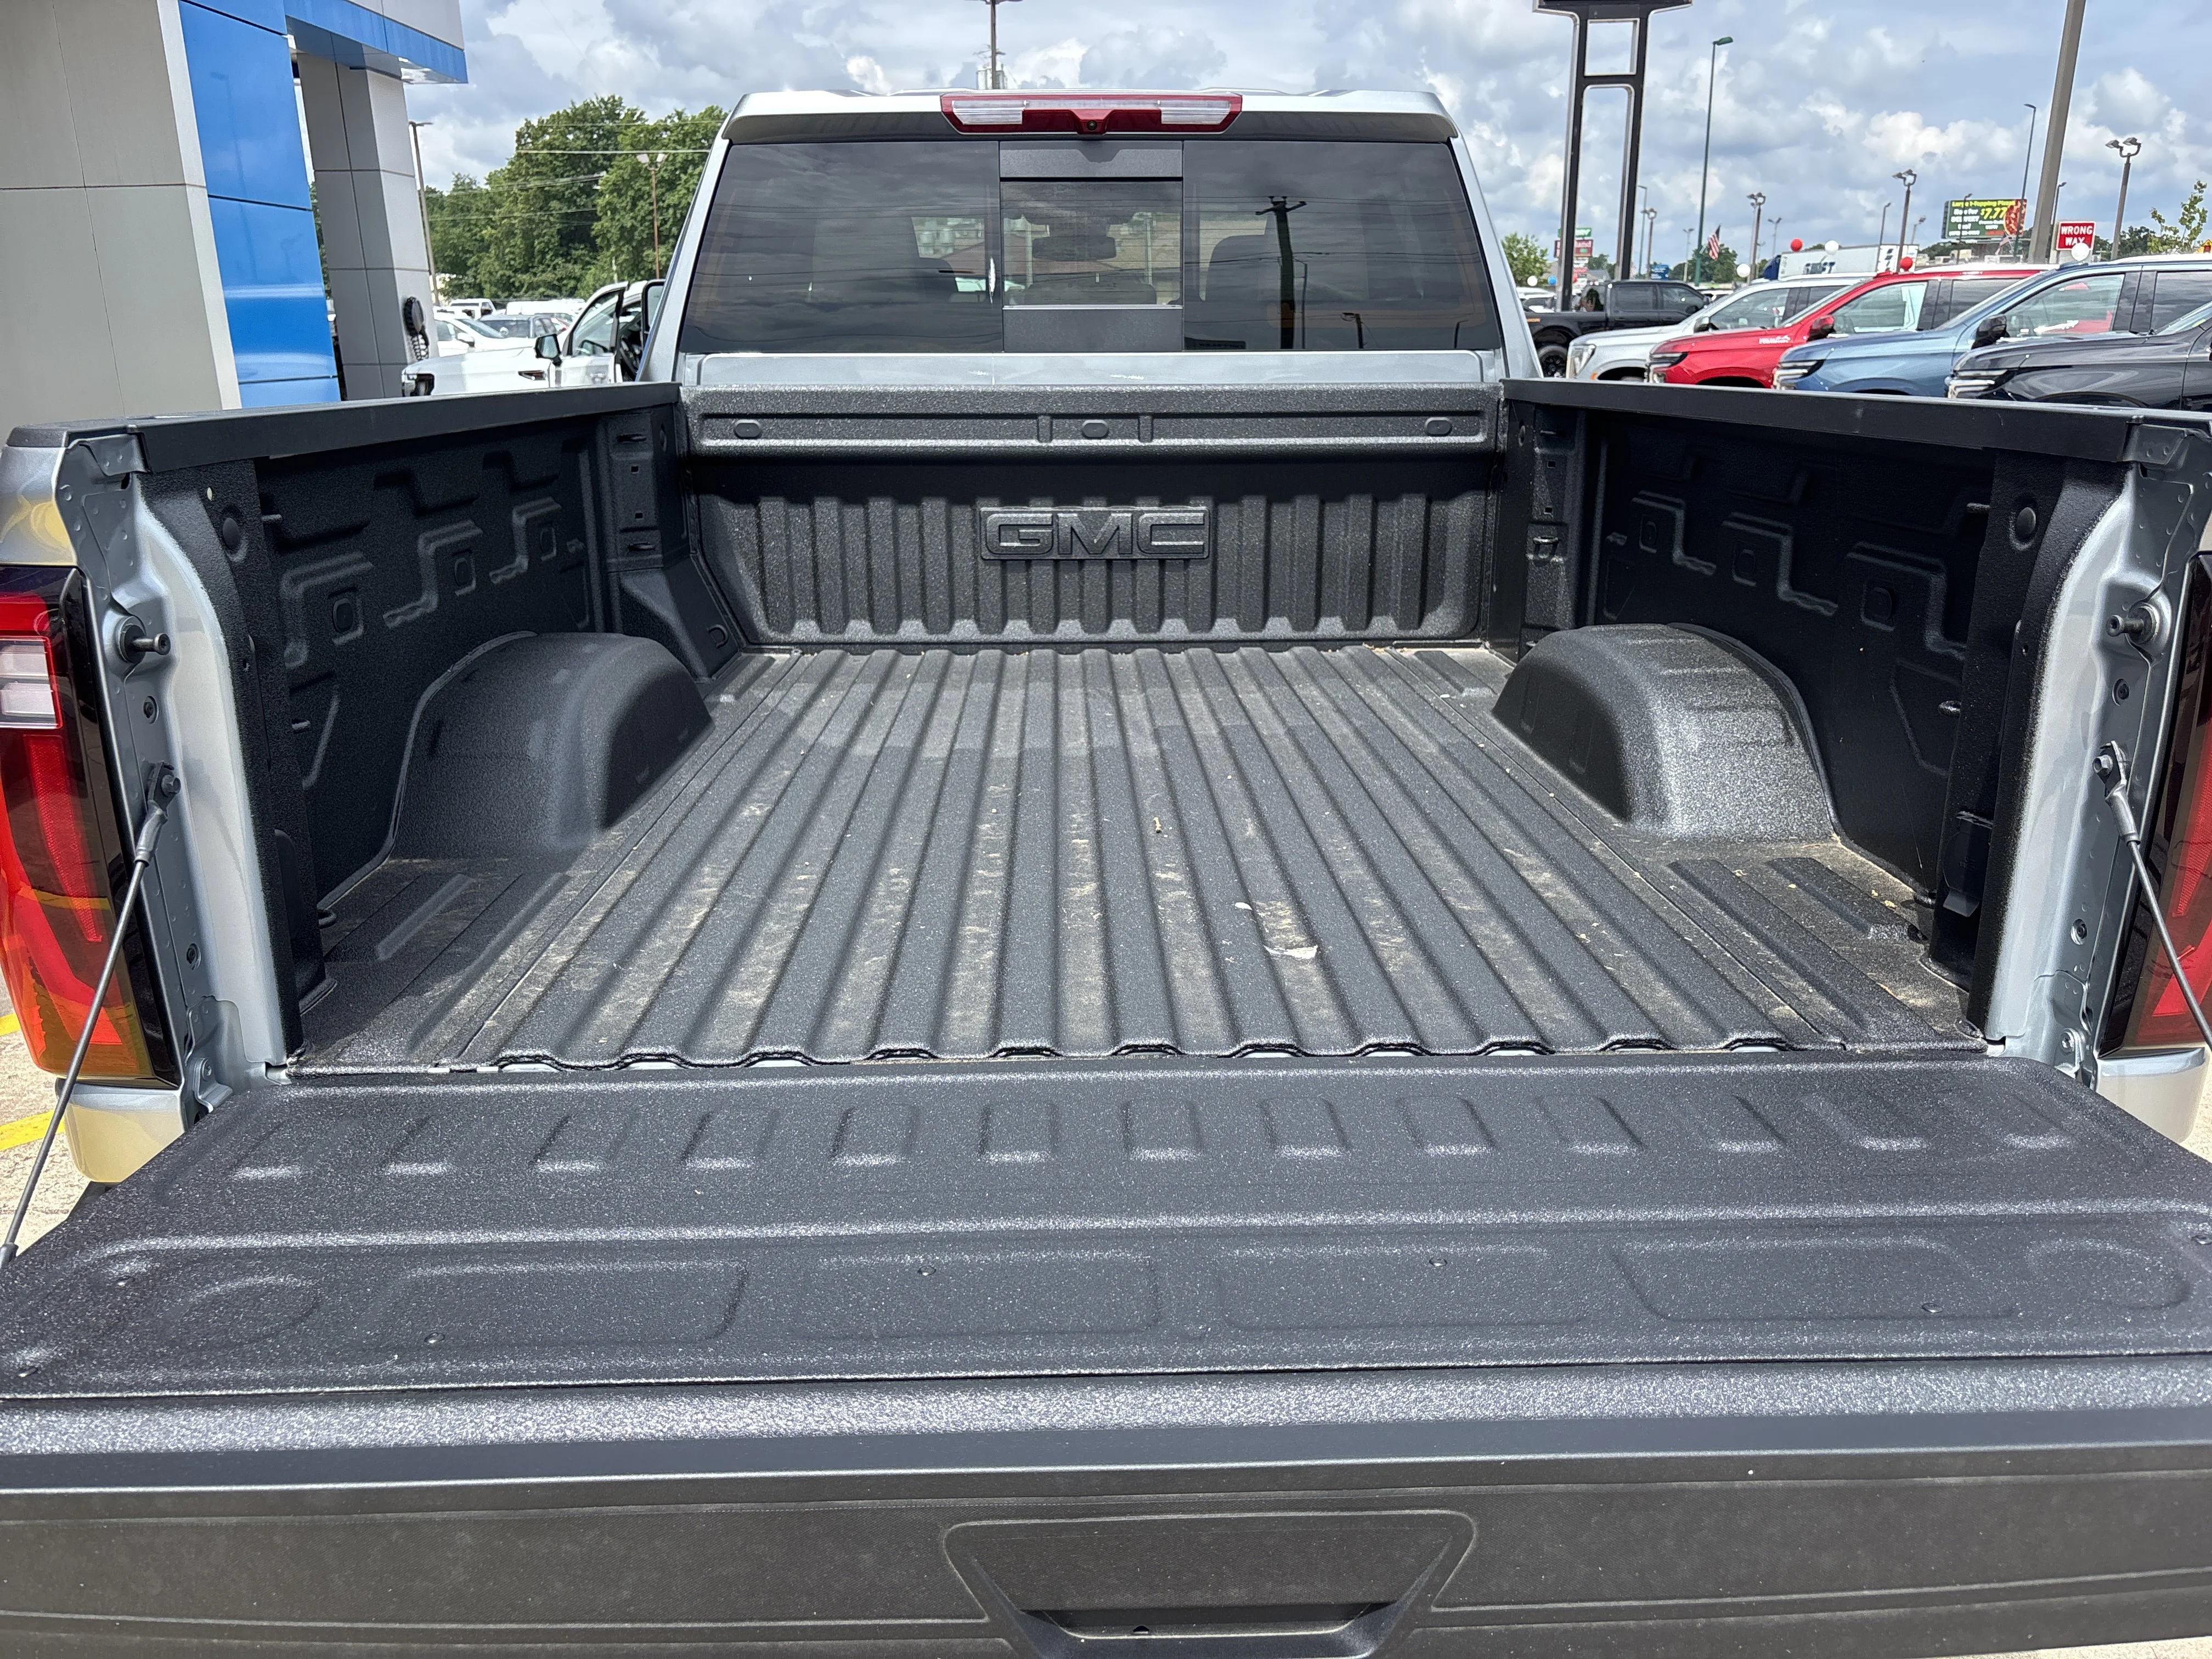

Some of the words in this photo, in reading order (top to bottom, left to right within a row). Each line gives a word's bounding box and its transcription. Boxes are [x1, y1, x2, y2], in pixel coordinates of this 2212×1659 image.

[1980, 207, 2008, 219] $7.77
[2061, 225, 2093, 235] WRONG
[2065, 236, 2085, 246] WAY
[986, 513, 1205, 556] GMC
